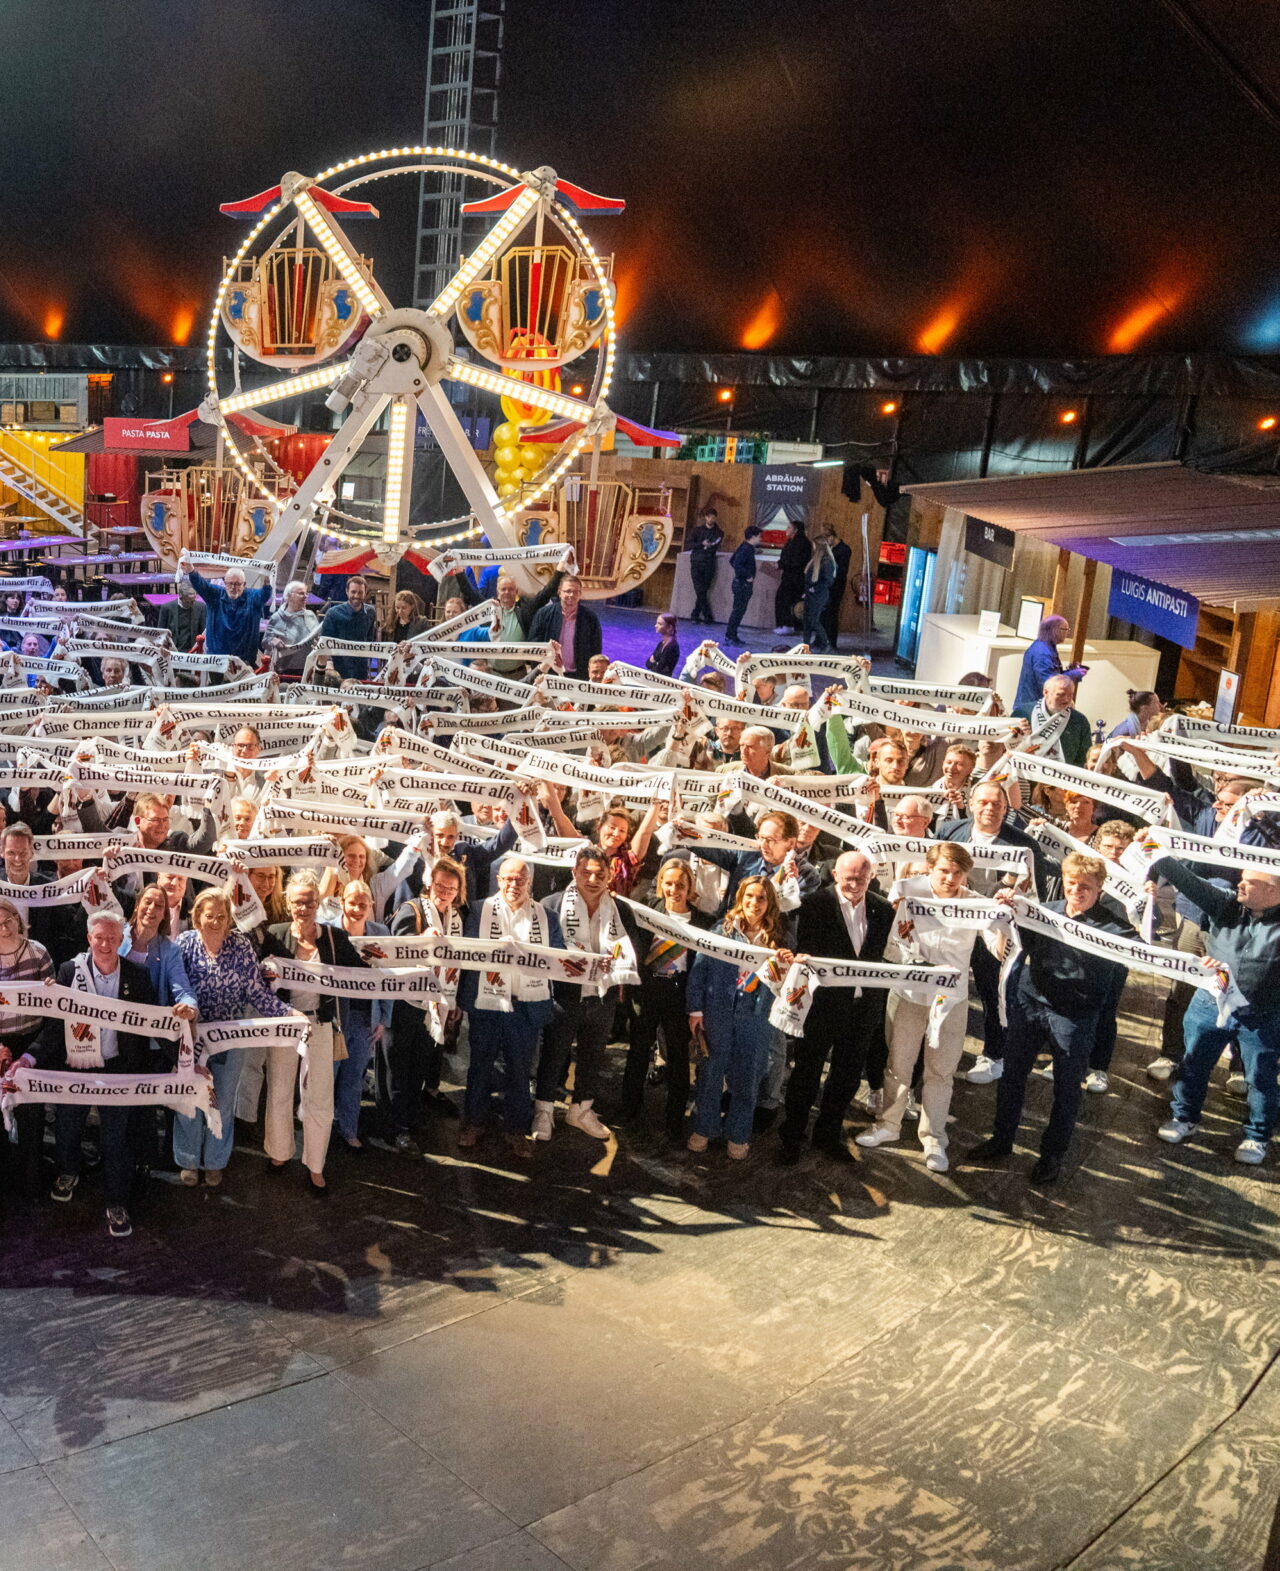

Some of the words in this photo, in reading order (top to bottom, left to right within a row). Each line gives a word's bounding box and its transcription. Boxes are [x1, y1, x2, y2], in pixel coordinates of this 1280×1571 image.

[121, 428, 145, 439] PASTA
[145, 430, 171, 440] PASTA
[764, 473, 807, 483] ABRÄUM-
[766, 483, 804, 493] STATION
[983, 526, 995, 544] BAR
[459, 552, 483, 560] Eine
[484, 552, 523, 561] Chance
[524, 550, 541, 558] für
[542, 549, 563, 558] alle.
[1121, 577, 1146, 599] LUIGIS
[1145, 587, 1188, 618] ANTIPASTI
[96, 620, 129, 632] Chance
[130, 625, 144, 635] für
[144, 628, 162, 638] alle.
[420, 645, 445, 655] Eine
[446, 645, 499, 654] Chance
[501, 645, 521, 655] für
[759, 658, 816, 670] Chance
[842, 663, 863, 685] alle.
[546, 678, 575, 691] Eine
[578, 683, 626, 698] Chance
[629, 689, 652, 702] für
[653, 693, 677, 707] alle.
[880, 684, 931, 697] Chance
[934, 687, 957, 698] für
[958, 690, 986, 705] alle.
[847, 699, 880, 718] Eine
[882, 710, 937, 730] Chance
[940, 721, 965, 734] für
[967, 724, 1001, 737] alle.
[1177, 718, 1212, 733] Eine
[1215, 723, 1277, 740] Chance
[14, 767, 37, 780] für
[527, 754, 559, 774] Eine
[561, 763, 616, 785] Chance
[618, 774, 644, 790] für
[644, 776, 671, 791] alle.
[460, 780, 486, 798] für
[487, 782, 515, 805] alle.
[1041, 765, 1101, 790] Chance
[1104, 785, 1131, 804] für
[1133, 798, 1162, 819] alle.
[264, 807, 296, 821] Eine
[299, 809, 359, 827] Chance
[360, 818, 385, 833] für
[1170, 836, 1213, 854] Eine
[168, 852, 195, 871] für
[197, 861, 229, 881] alle.
[695, 937, 722, 953] für
[722, 946, 759, 966] alle.
[1025, 906, 1060, 932] Eine
[1062, 921, 1126, 954] Chance
[1129, 945, 1160, 967] für
[1162, 956, 1205, 978] alle.
[394, 946, 430, 960] Eine
[432, 946, 488, 962] Chance
[490, 948, 515, 965] für
[515, 952, 552, 971] alle.
[281, 966, 317, 985] Eine
[319, 973, 377, 992] Chance
[379, 976, 406, 993] für
[407, 976, 442, 993] alle.
[16, 991, 53, 1008] Eine
[56, 995, 118, 1023] Chance
[120, 1008, 149, 1030] für
[206, 1026, 271, 1045] Chance
[273, 1023, 303, 1042] für
[27, 1078, 65, 1096] Eine
[133, 1080, 161, 1096] für
[162, 1080, 199, 1096] alle.
